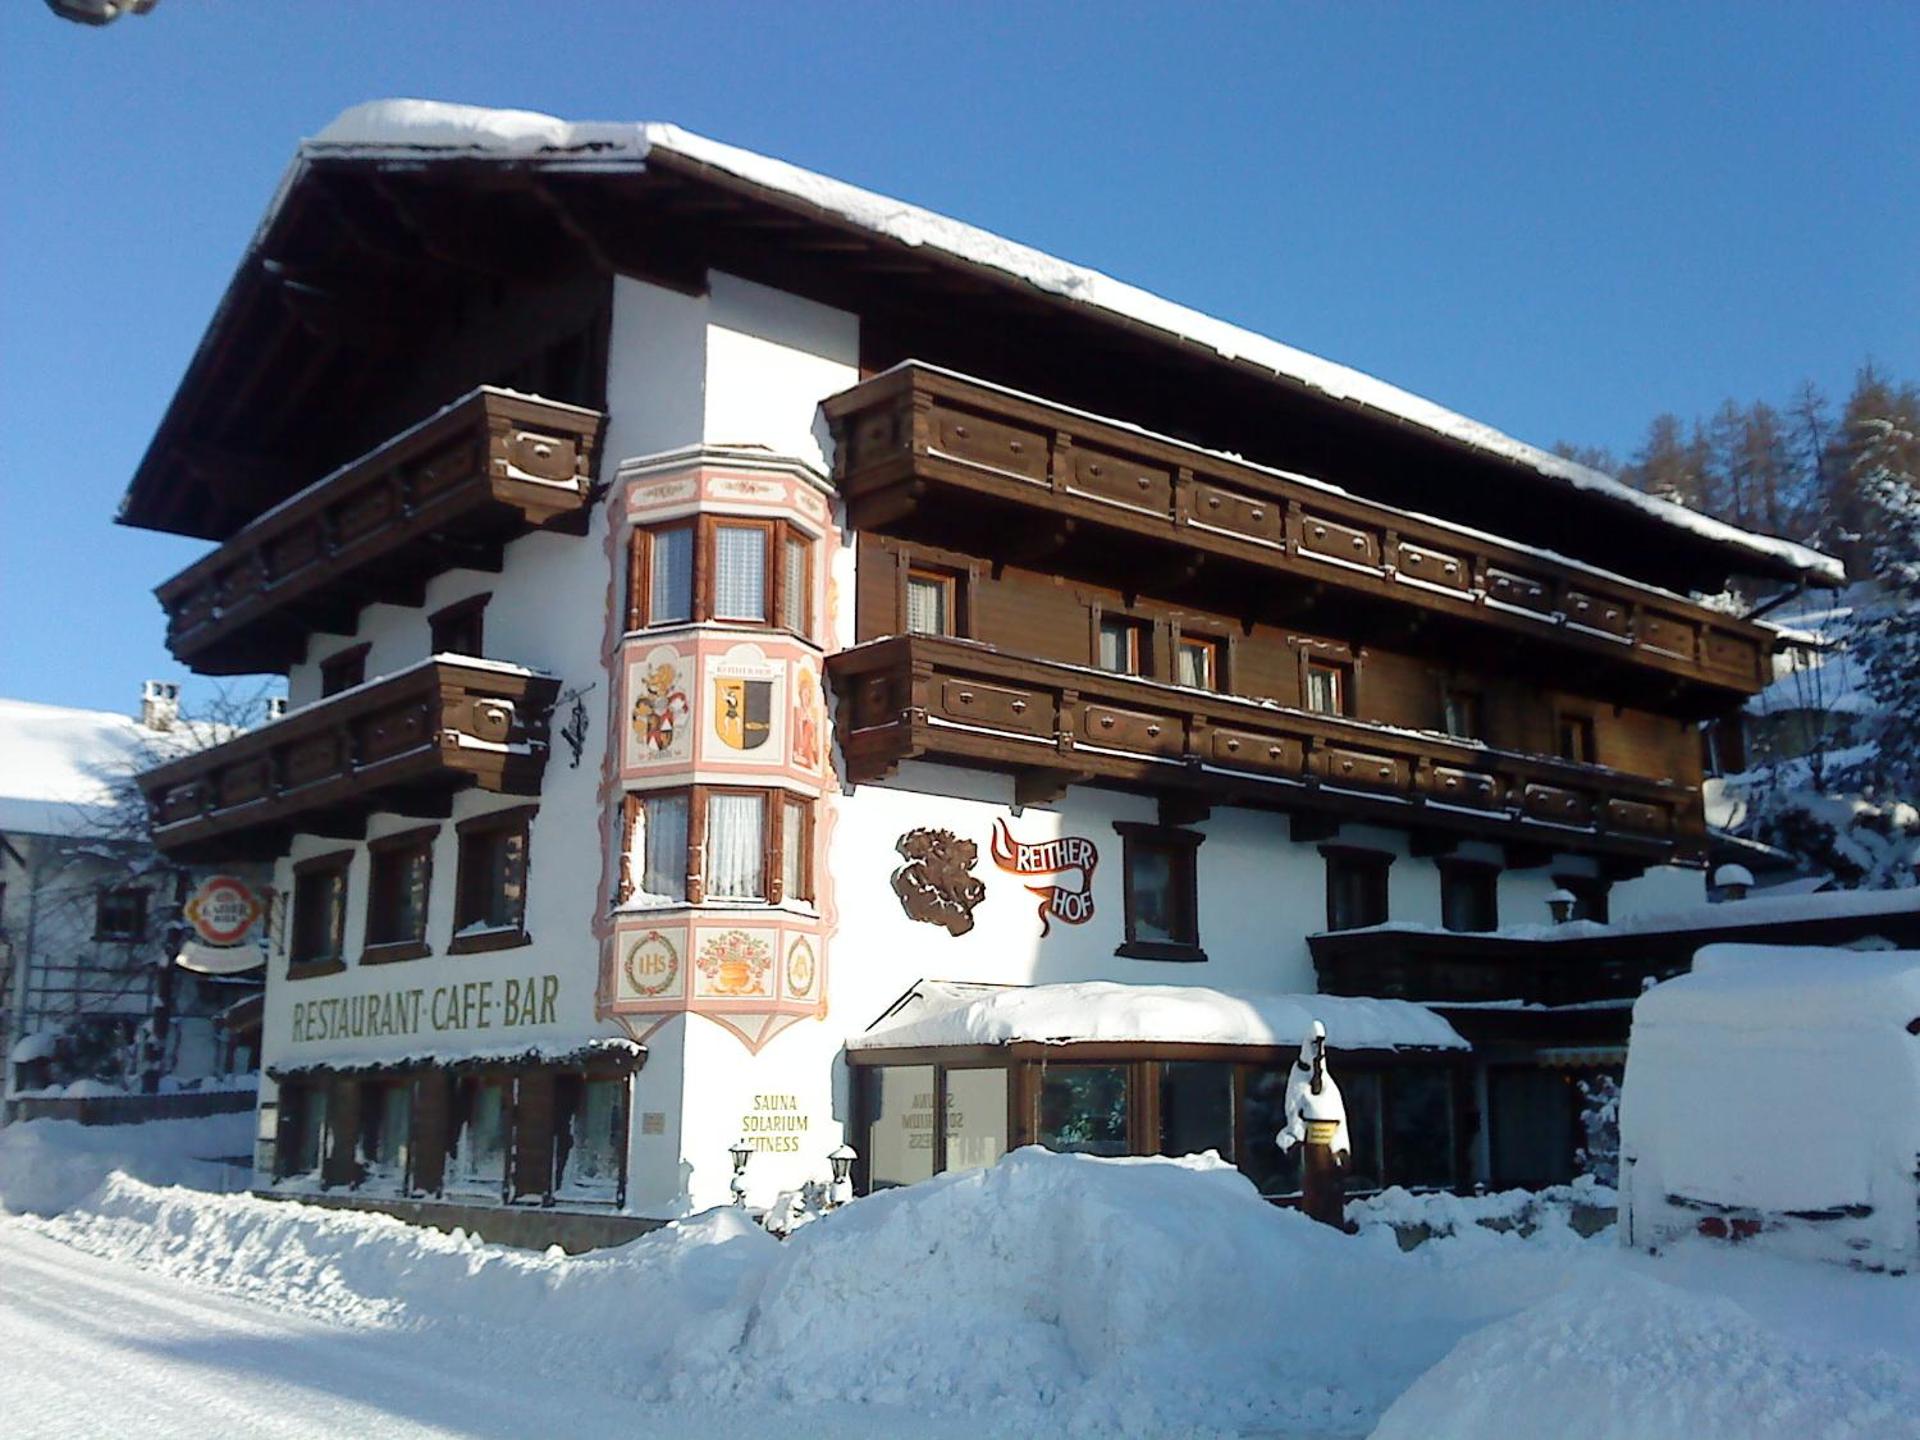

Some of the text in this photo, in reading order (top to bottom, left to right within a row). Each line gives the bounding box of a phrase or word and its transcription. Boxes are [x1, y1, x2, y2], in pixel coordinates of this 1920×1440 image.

[1051, 887, 1092, 920] HOF
[291, 974, 559, 1042] RESTAURANT CAFE BAR
[753, 1094, 797, 1110] SAUNA
[742, 1115, 808, 1132] SOLARIUM
